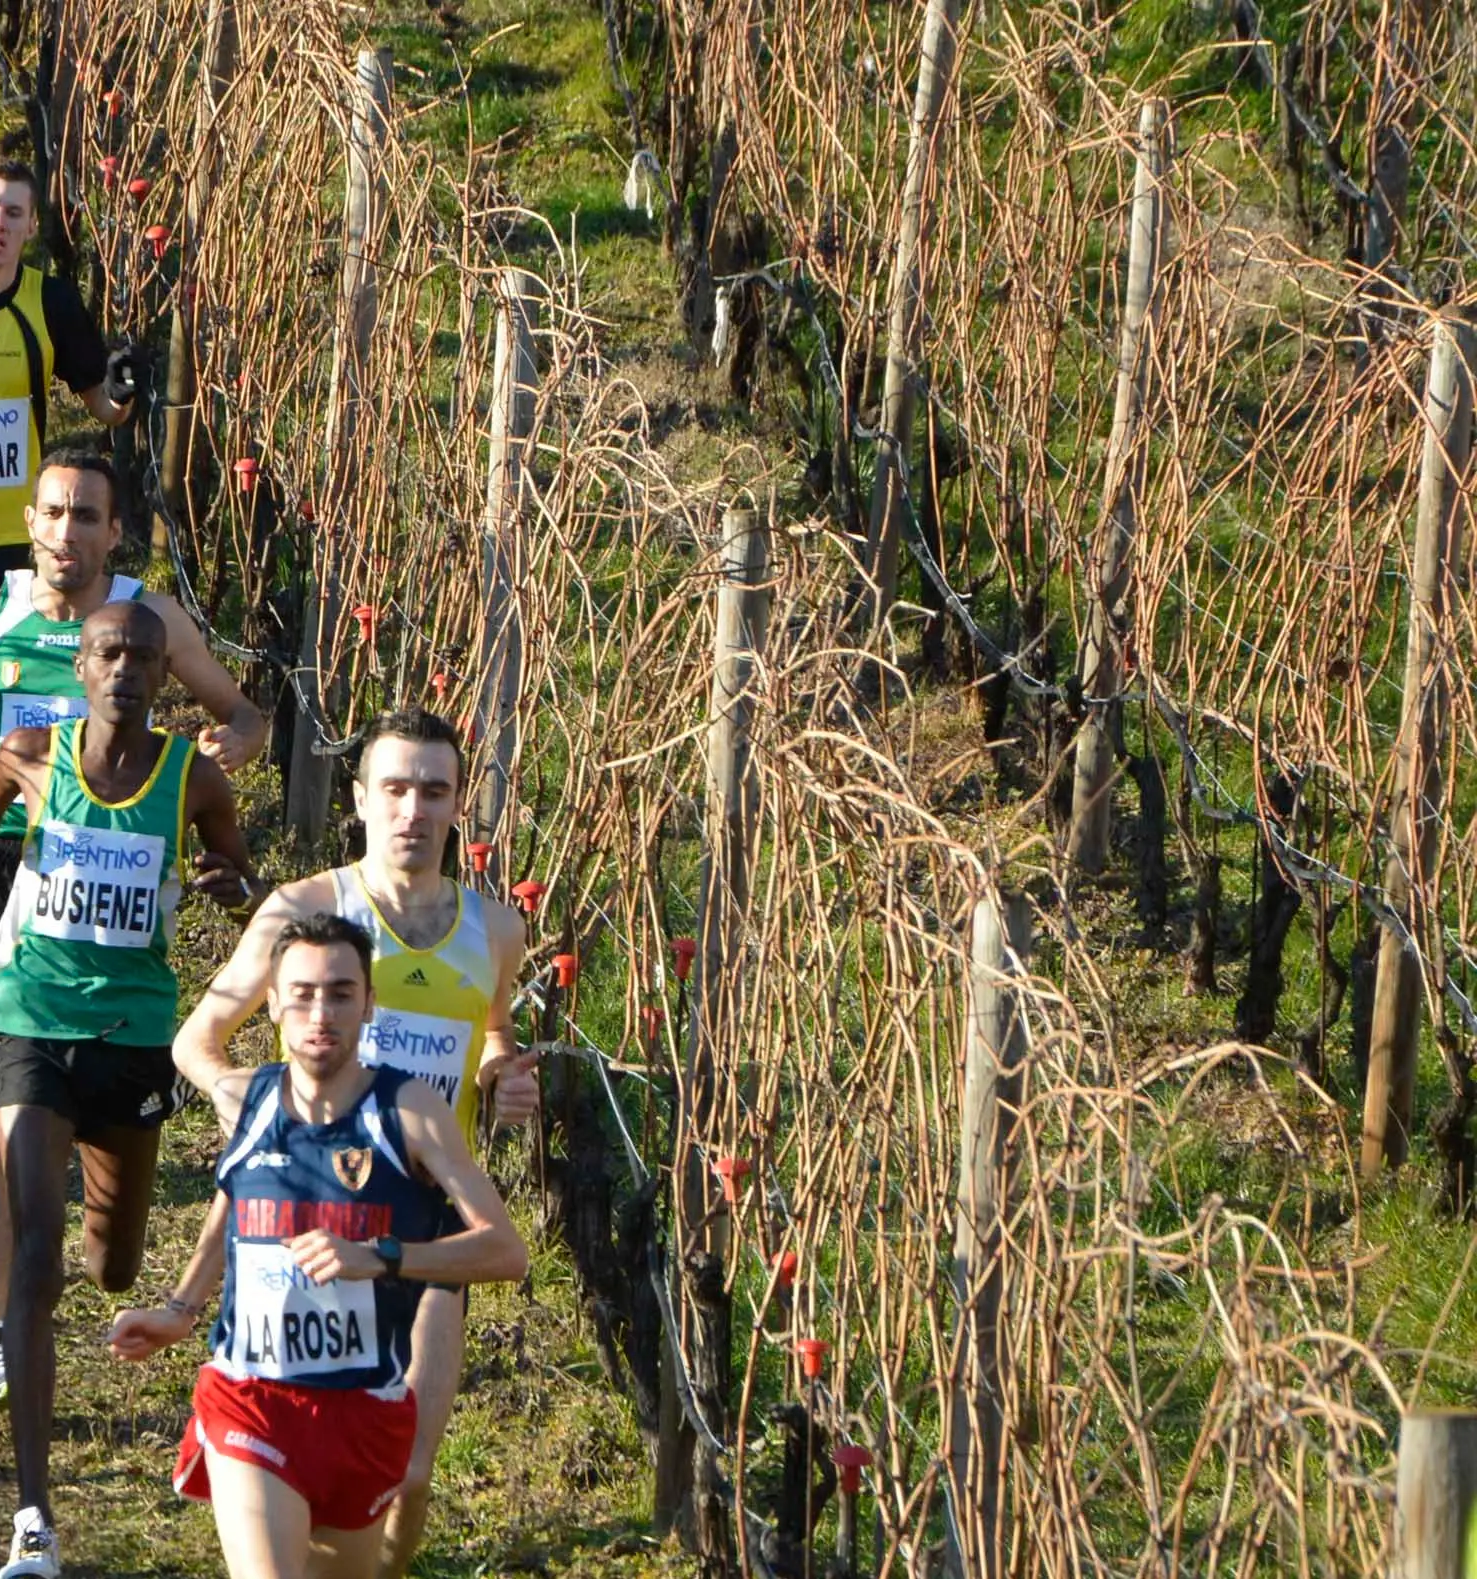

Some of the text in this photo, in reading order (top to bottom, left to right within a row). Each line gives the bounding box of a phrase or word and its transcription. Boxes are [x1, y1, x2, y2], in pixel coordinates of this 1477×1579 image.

[54, 836, 151, 870] TRENTINO
[36, 872, 156, 933] BUSIENEI
[366, 1023, 457, 1058] RENTINO
[245, 1310, 364, 1364] LA ROSA
